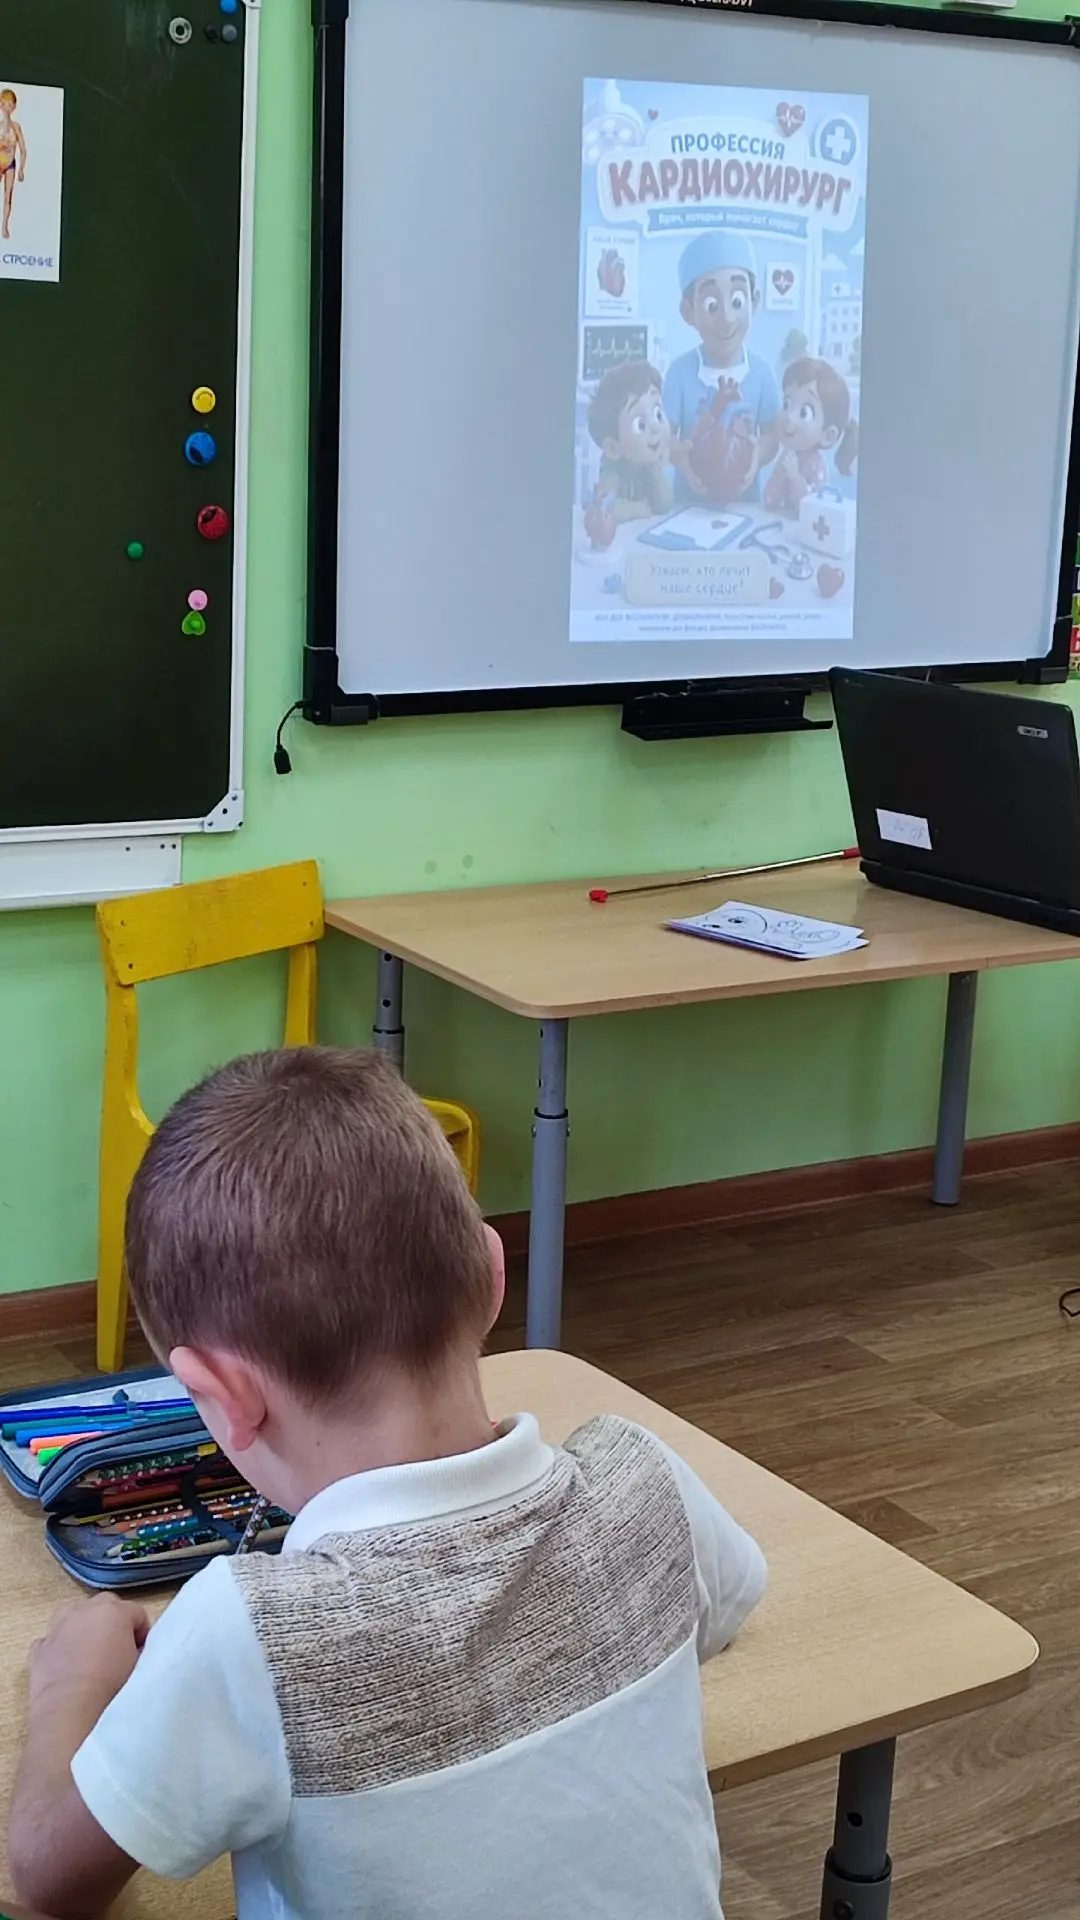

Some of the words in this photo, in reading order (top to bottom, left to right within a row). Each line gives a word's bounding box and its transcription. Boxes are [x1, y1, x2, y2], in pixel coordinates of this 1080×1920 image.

[670, 132, 785, 160] ПРОФЕССИЯ
[608, 157, 852, 216] КАРДИОХИРУРГ
[2, 253, 54, 268] СТРОЕНИЕ
[696, 565, 715, 576] кто
[660, 582, 693, 594] наше
[695, 578, 744, 596] сердце!
